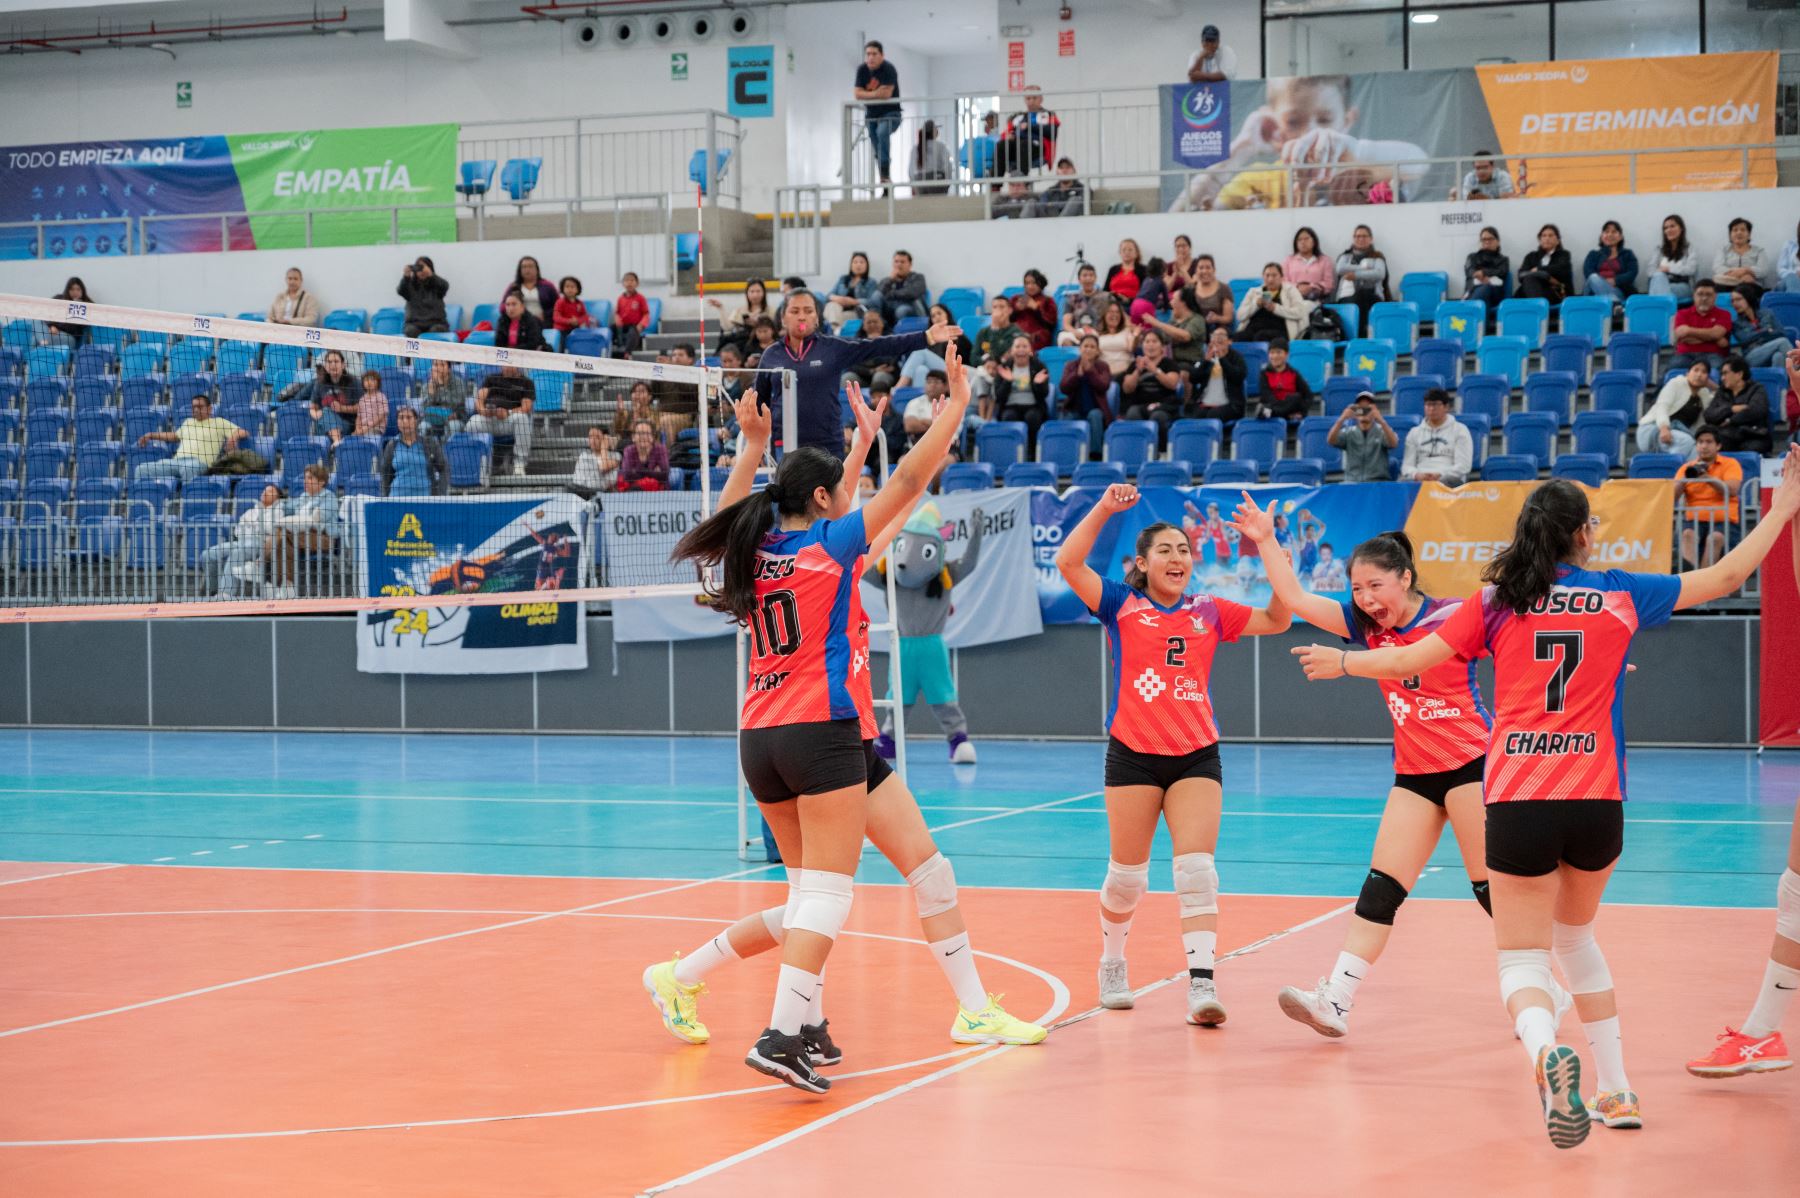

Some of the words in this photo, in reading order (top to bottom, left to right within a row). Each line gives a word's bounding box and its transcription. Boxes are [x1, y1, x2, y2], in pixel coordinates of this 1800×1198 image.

[734, 71, 768, 104] C
[1520, 100, 1760, 134] DETERMINACIÓN
[1182, 131, 1222, 140] JUEGOS
[8, 152, 55, 169] TODO
[58, 147, 134, 167] EMPIEZA
[138, 142, 186, 166] AQUÍ
[273, 159, 412, 197] EMPATÍA
[1441, 212, 1483, 225] PREFERENCIA
[614, 512, 687, 536] COLEGIO
[754, 556, 796, 581] USCO
[501, 602, 559, 618] OLIMPIA
[1513, 591, 1604, 615] USCO
[392, 609, 429, 635] 24
[750, 589, 802, 659] 10
[1165, 635, 1187, 667] 2
[1174, 675, 1198, 690] Caja
[1534, 630, 1584, 713] 7
[1173, 688, 1204, 702] Cusco
[1415, 697, 1446, 708] Caja
[1418, 707, 1461, 721] Cusco
[1505, 731, 1597, 757] CHARITO
